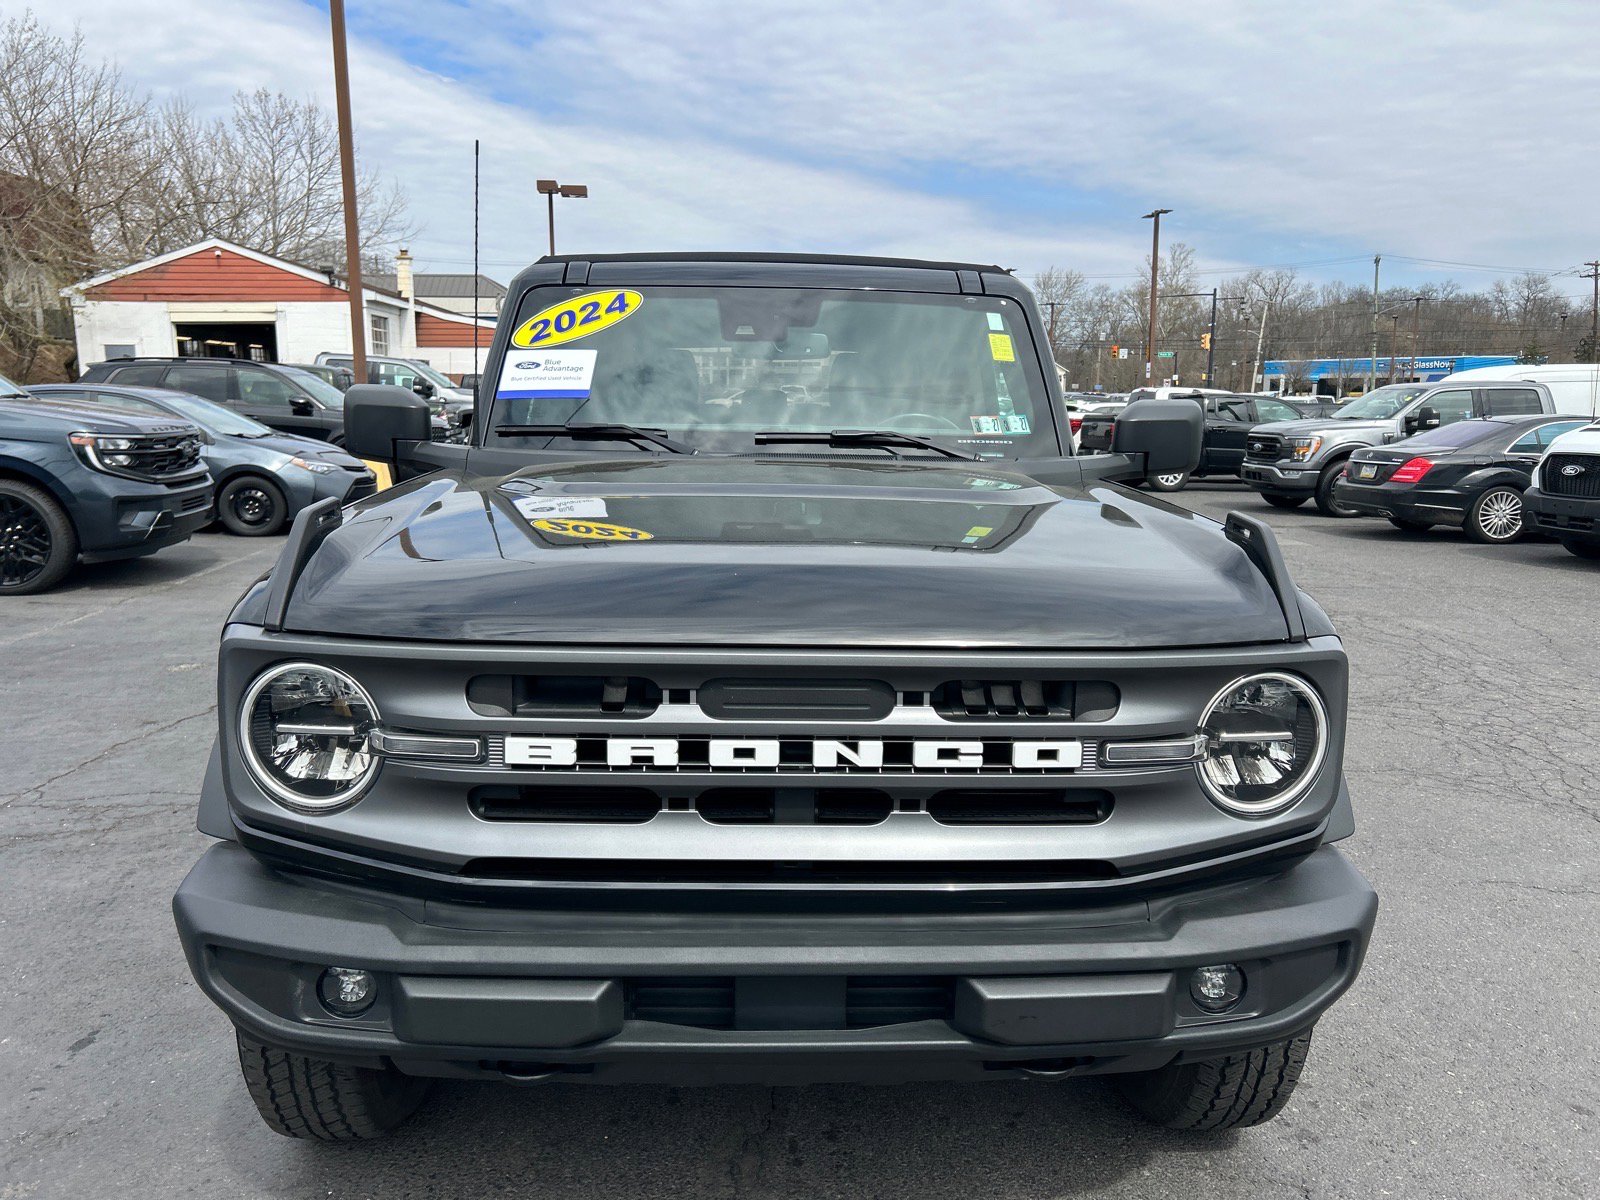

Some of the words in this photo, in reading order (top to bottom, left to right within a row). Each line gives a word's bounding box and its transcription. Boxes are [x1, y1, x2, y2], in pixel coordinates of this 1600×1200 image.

[529, 292, 629, 345] 2024
[517, 362, 539, 370] Ford
[542, 365, 584, 373] Advantage
[505, 736, 1083, 769] BRONCO
